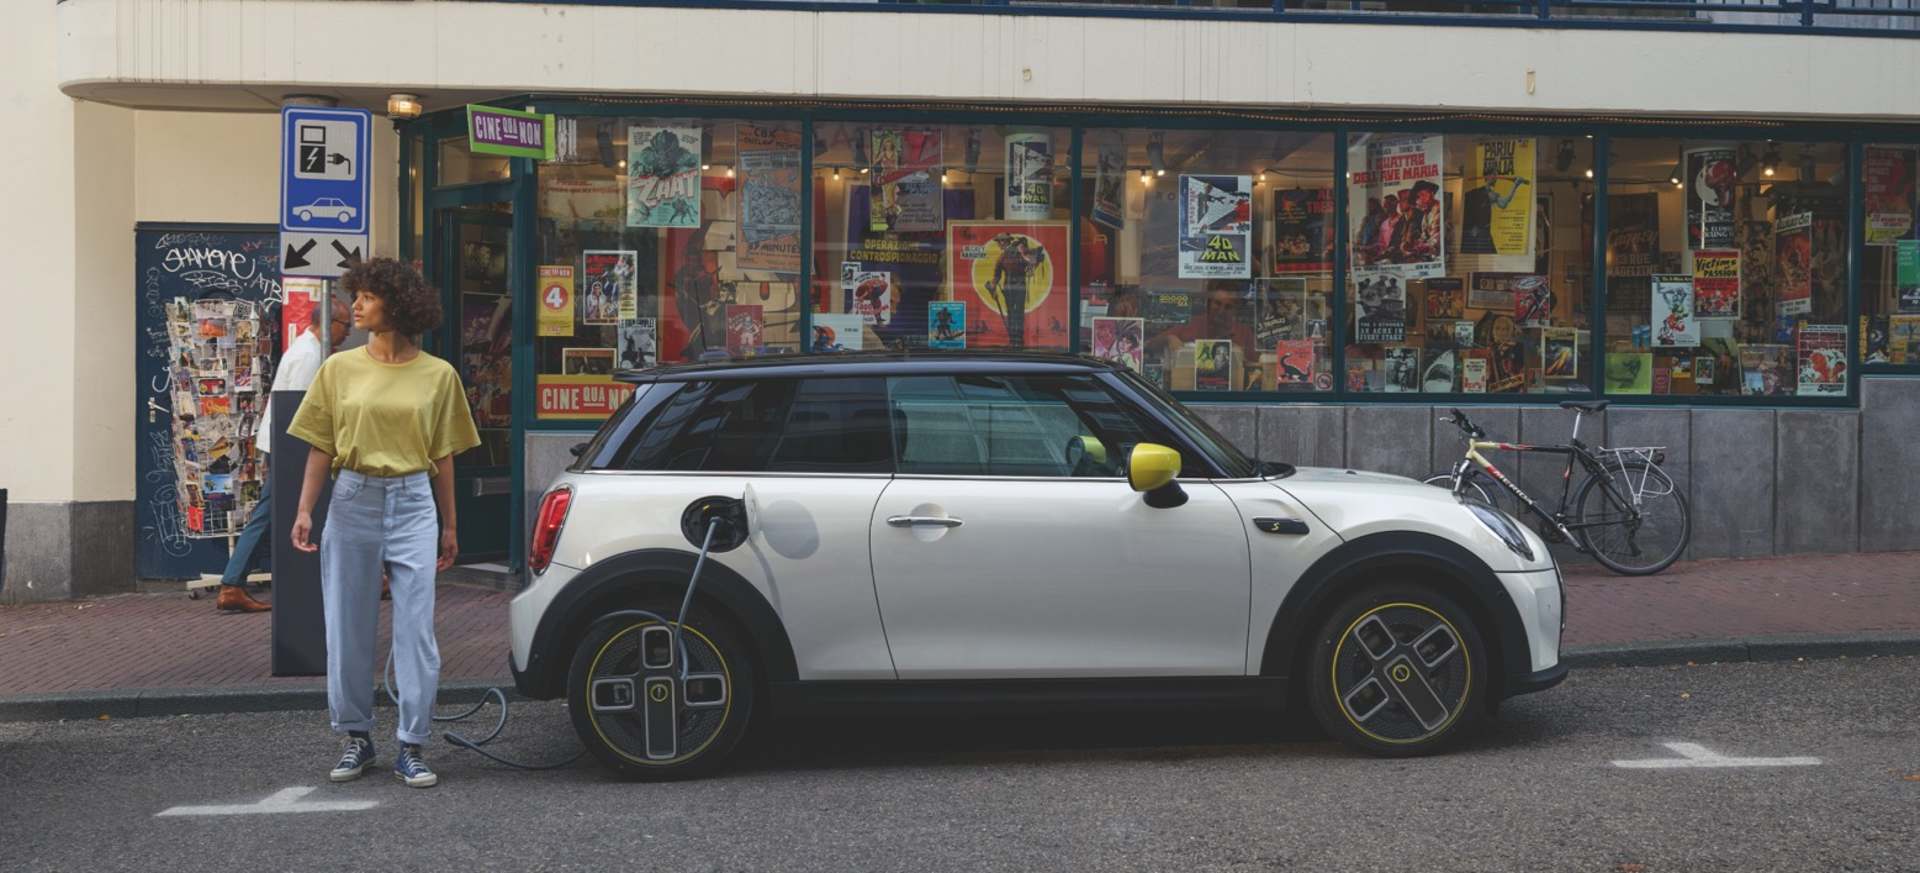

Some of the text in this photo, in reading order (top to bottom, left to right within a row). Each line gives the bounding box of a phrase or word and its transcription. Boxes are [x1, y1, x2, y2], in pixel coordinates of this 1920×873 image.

[475, 115, 502, 140] CINE
[502, 117, 518, 134] QUA
[519, 121, 542, 145] NON
[1403, 164, 1439, 180] MARIA
[637, 170, 698, 208] ZAAT
[1208, 235, 1233, 250] 4D
[1200, 250, 1241, 262] MAN
[1696, 258, 1737, 272] Victims
[1704, 270, 1738, 278] PASSION
[546, 287, 563, 308] 4
[542, 386, 635, 411] CINE QUA NO
[1271, 521, 1281, 531] S
